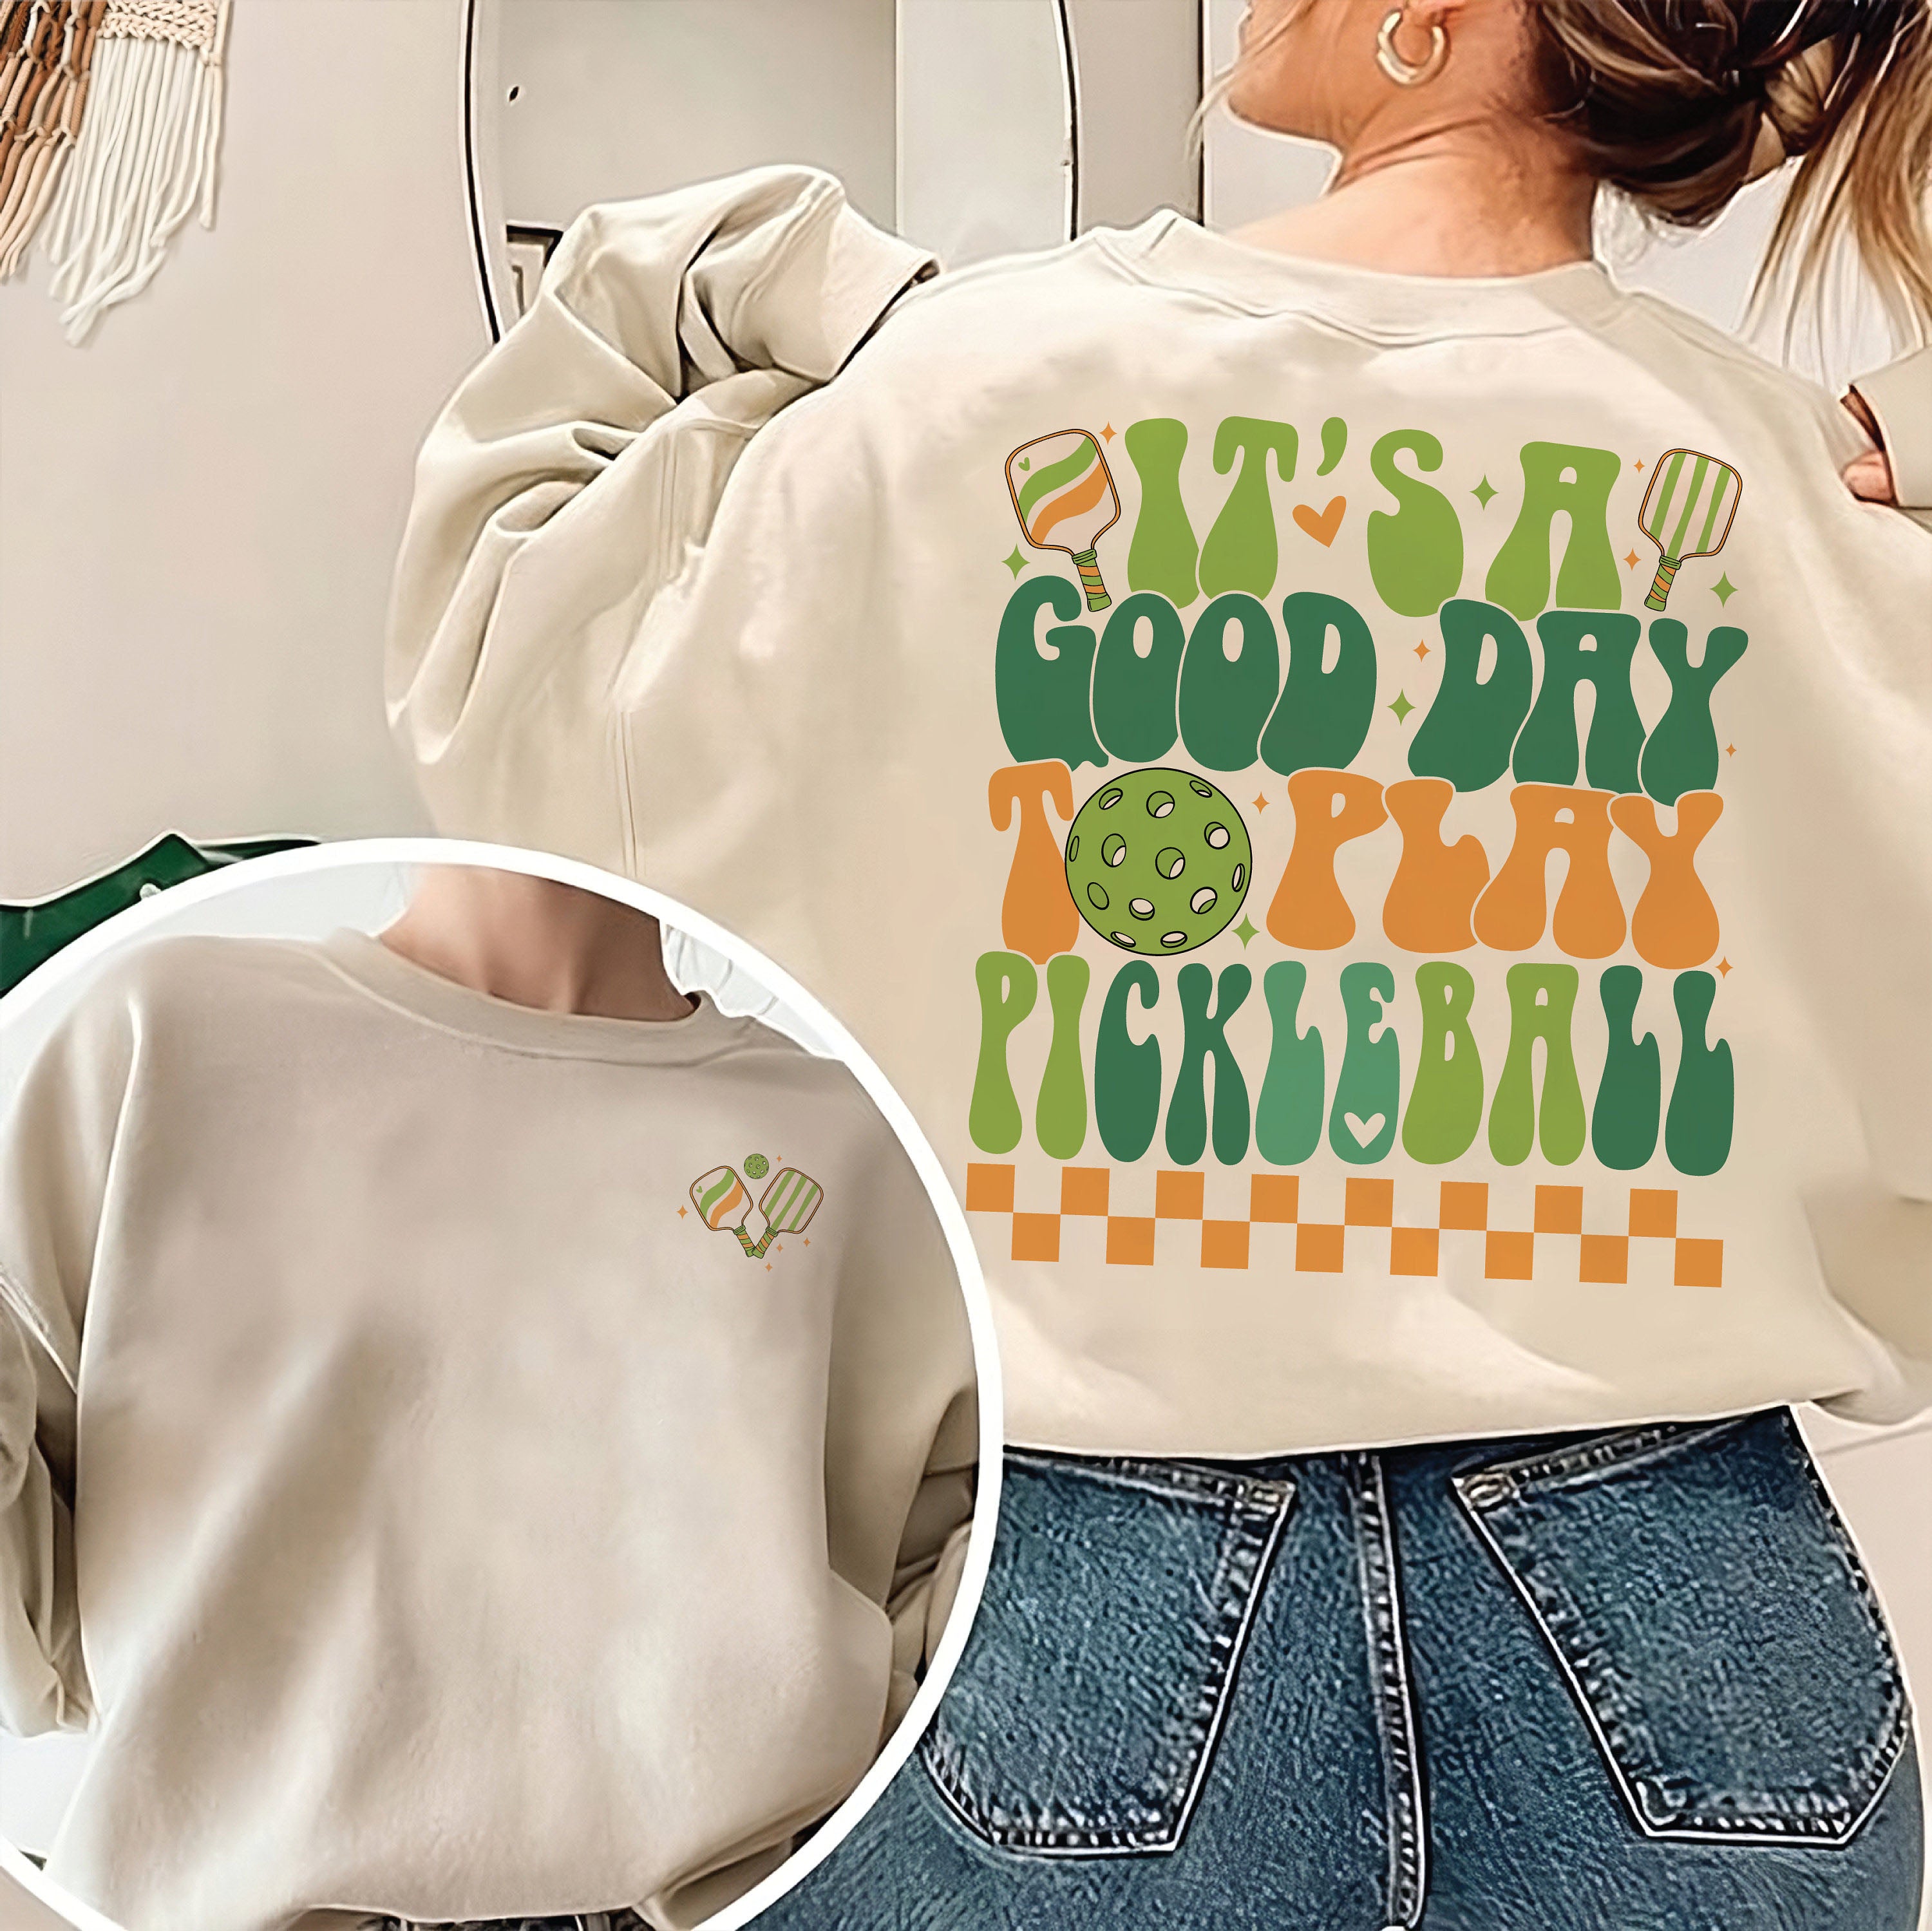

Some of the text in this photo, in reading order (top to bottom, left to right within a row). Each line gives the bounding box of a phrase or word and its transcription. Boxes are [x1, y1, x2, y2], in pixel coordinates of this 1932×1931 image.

[1124, 416, 1622, 621] IT'S A
[995, 576, 1748, 807] GOOD DAY
[1266, 769, 1724, 970] PLAY
[969, 951, 1734, 1176] PICKLEBALL
